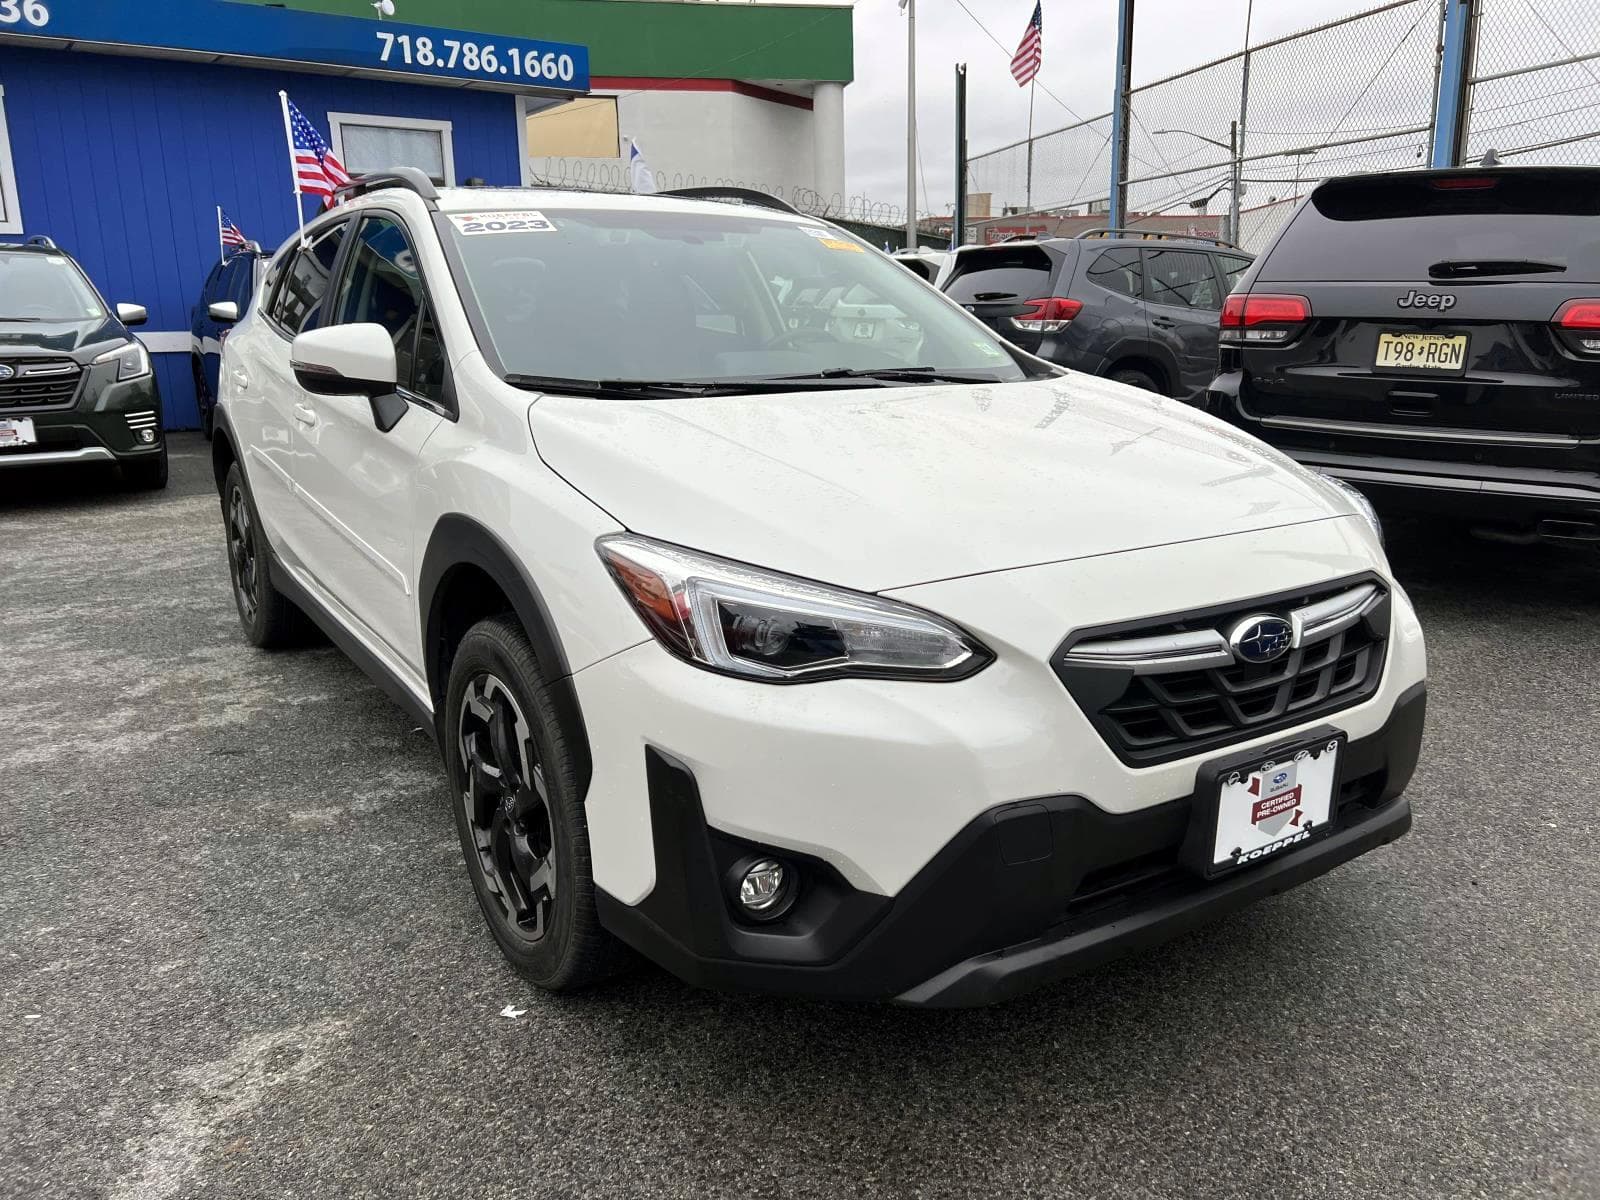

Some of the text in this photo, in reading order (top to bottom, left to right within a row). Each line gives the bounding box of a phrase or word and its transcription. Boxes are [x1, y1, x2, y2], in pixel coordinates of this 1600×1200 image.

[376, 32, 574, 82] 718.786.1660
[463, 220, 550, 233] 2023
[1398, 290, 1457, 312] Jeep
[1257, 798, 1297, 819] PRE-OWNED
[1261, 792, 1294, 810] CERTIFIED
[1237, 830, 1311, 865] KOEPPEL
